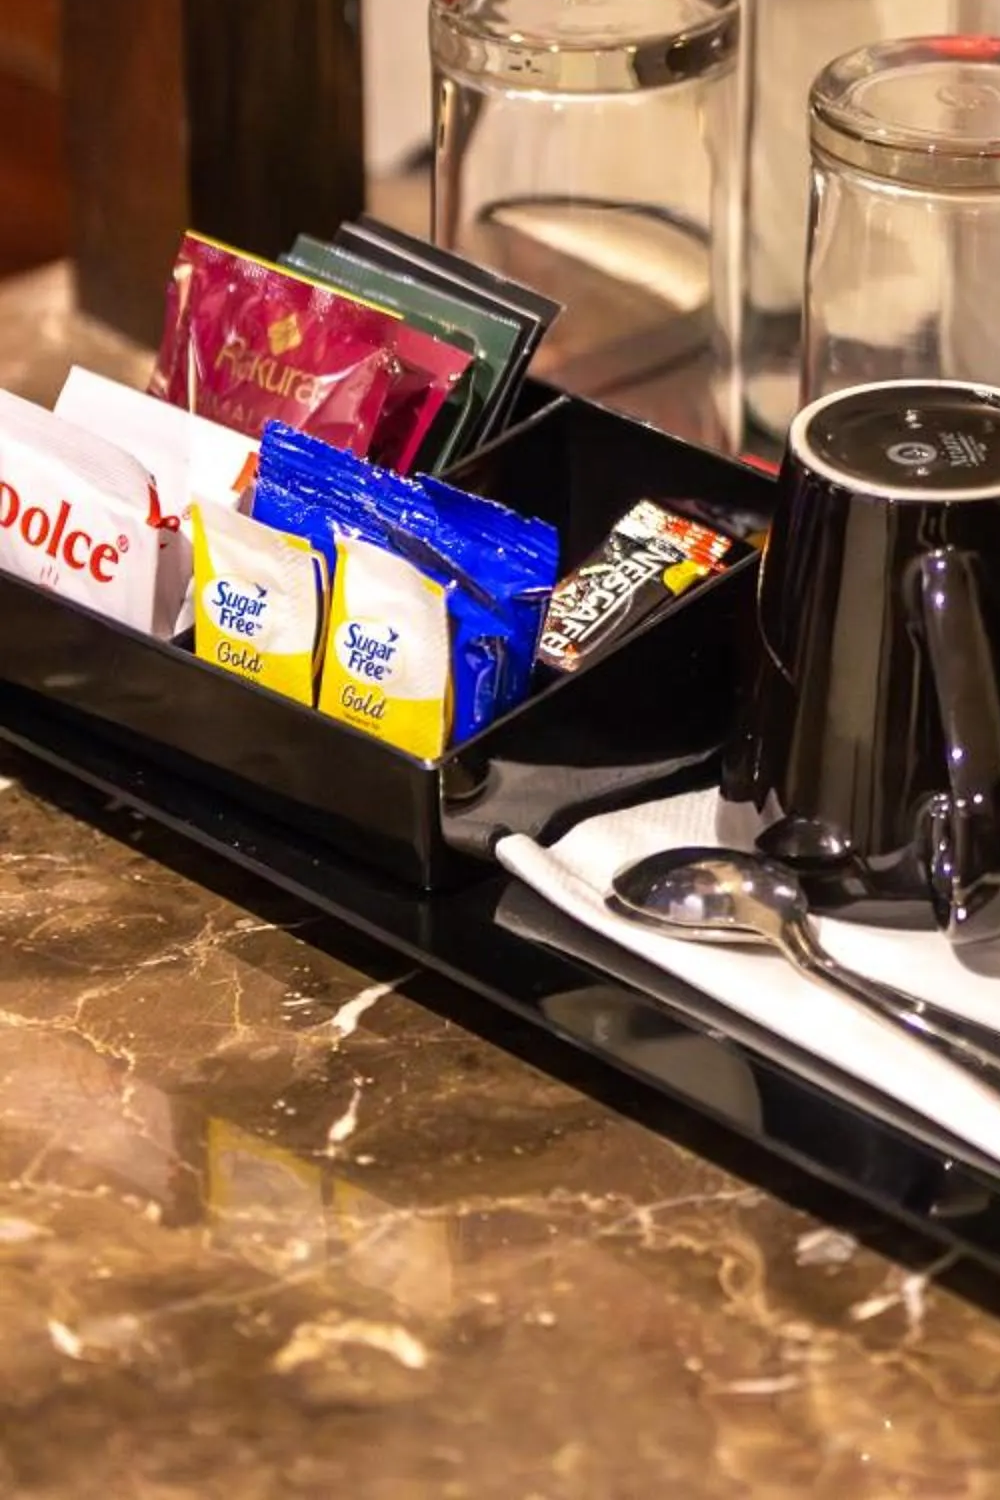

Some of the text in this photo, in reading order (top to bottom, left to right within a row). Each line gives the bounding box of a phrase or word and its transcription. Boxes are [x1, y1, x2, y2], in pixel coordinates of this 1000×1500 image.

[212, 580, 267, 617] Sugar
[220, 607, 255, 636] Free
[217, 641, 263, 673] Gold
[343, 623, 396, 661] Sugar
[348, 650, 384, 681] Free
[341, 685, 386, 720] Gold
